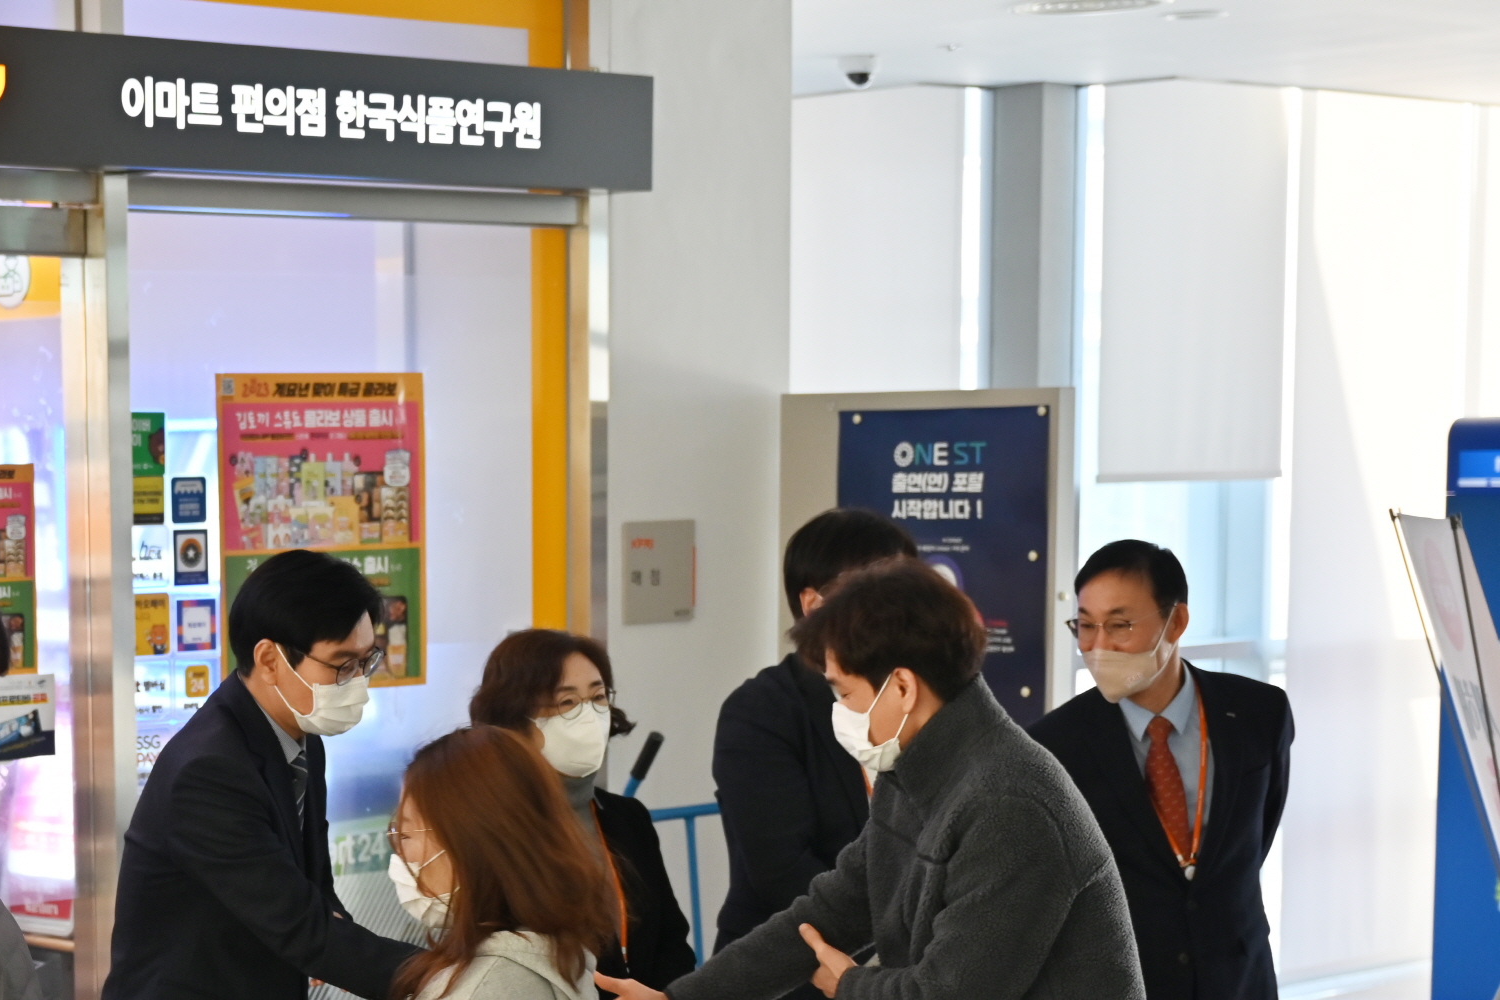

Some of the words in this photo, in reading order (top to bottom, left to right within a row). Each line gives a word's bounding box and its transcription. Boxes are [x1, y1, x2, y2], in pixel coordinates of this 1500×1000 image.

[120, 75, 223, 130] 이마트
[231, 83, 327, 138] 편의점
[335, 89, 542, 150] 한국식품연구원
[369, 409, 393, 427] 출시
[892, 499, 972, 519] 시작합니다
[364, 556, 389, 575] 출시
